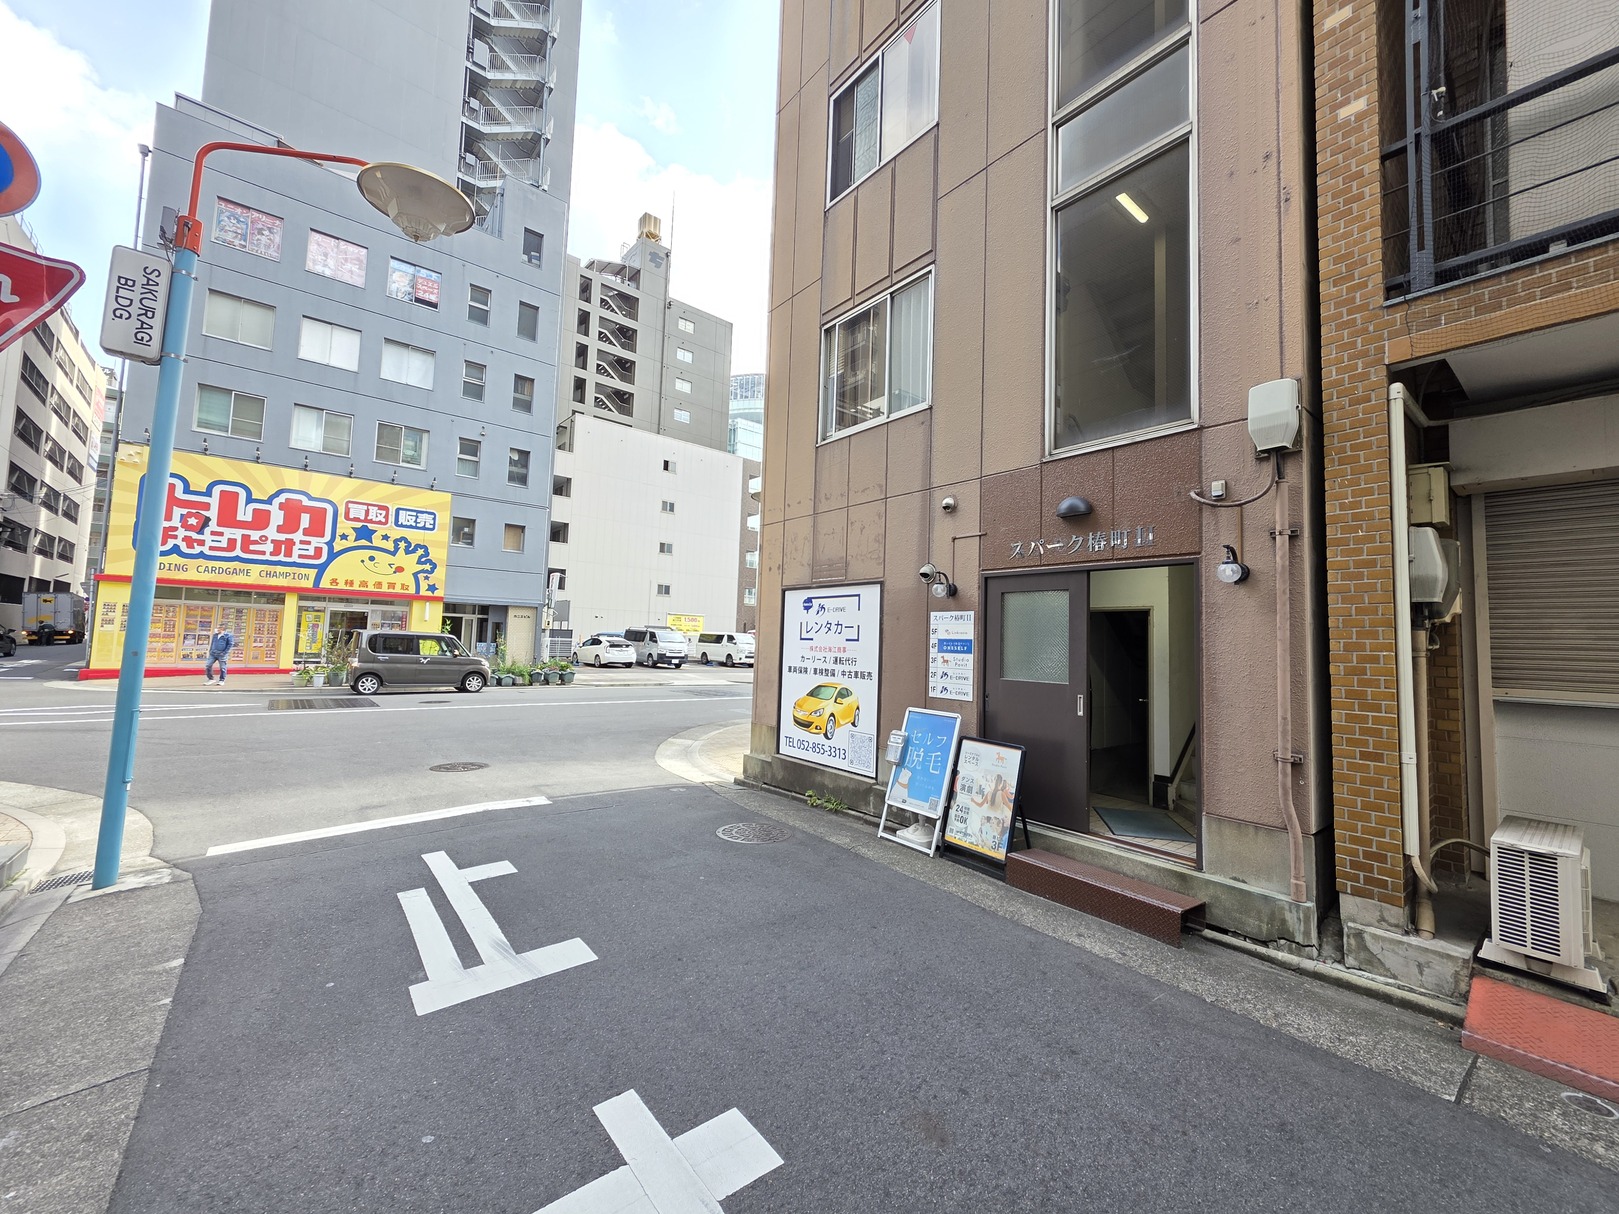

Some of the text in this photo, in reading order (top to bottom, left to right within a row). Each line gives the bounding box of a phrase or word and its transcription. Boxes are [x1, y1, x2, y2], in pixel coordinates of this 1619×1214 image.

[111, 275, 136, 321] BLDG.
[133, 266, 161, 347] SAKURAGI
[164, 482, 328, 538] トレカ
[348, 503, 387, 522] 買取
[397, 510, 434, 528] 販売
[161, 526, 323, 560] チャンピオン
[196, 565, 252, 578] CARDGAME
[258, 570, 310, 582] CHAMPION
[329, 578, 410, 591] 各種高価買取
[805, 620, 854, 635] レンタカー
[931, 642, 937, 650] 4F
[800, 655, 828, 664] カーリース
[832, 656, 857, 666] 運転代行
[787, 665, 808, 674] 車両保険
[813, 667, 836, 677] 車検整備
[841, 670, 873, 681] 中古車販売
[911, 730, 947, 748] セルフ
[784, 735, 847, 760] TEL 052-855-3313
[904, 746, 942, 775] 脱毛
[964, 754, 980, 762] レンタル
[961, 776, 975, 784] ダンス
[959, 783, 974, 795] 演劇
[955, 804, 964, 813] 24
[960, 814, 969, 826] OK
[991, 840, 1003, 851] 3F
[397, 850, 599, 1017] 止
